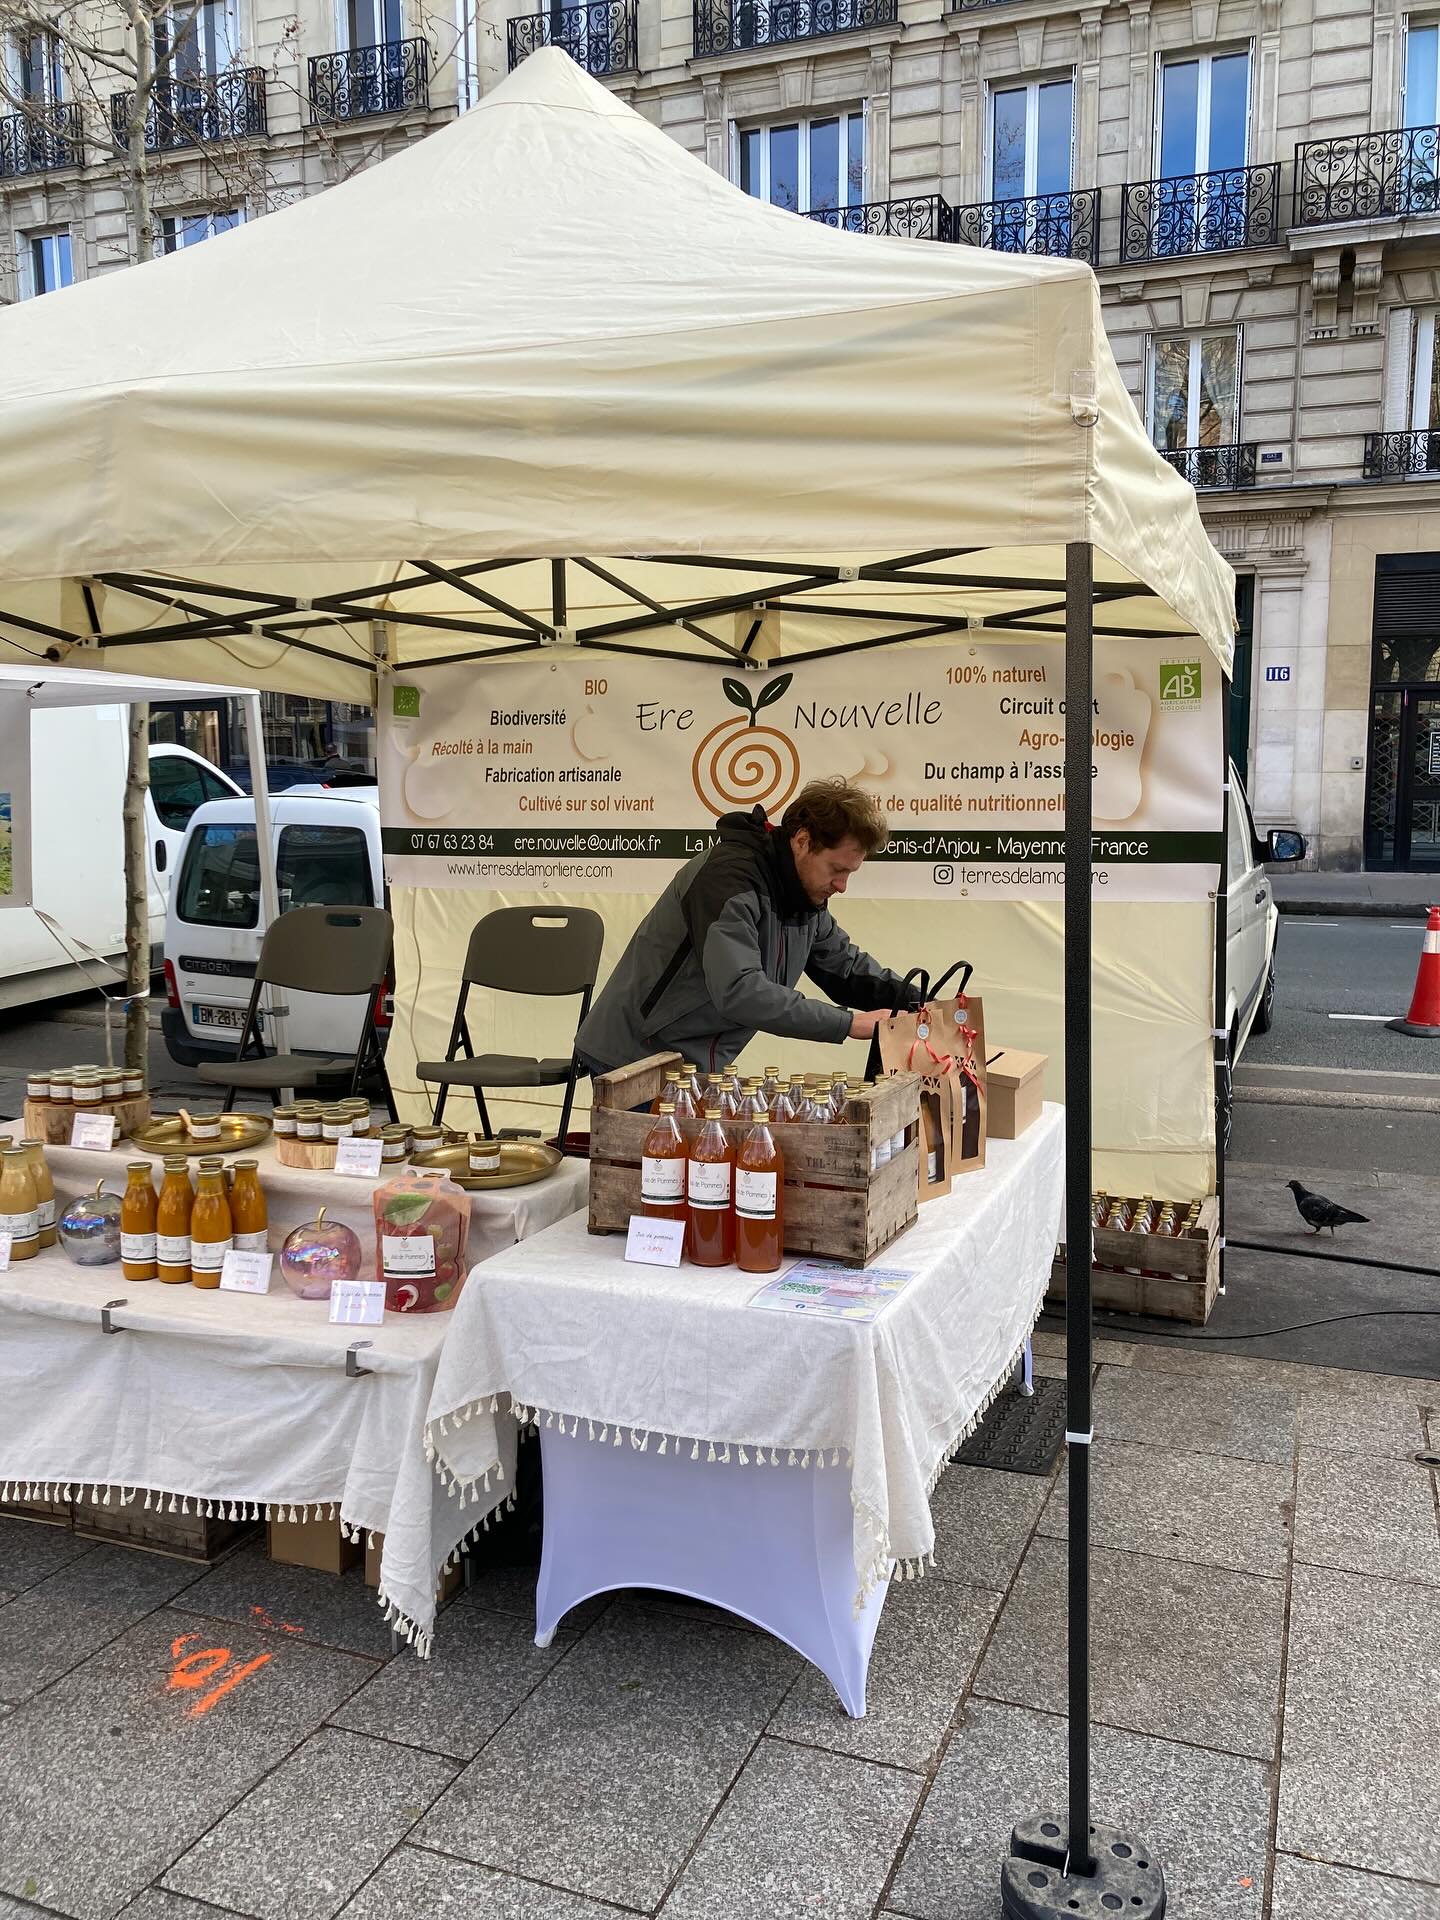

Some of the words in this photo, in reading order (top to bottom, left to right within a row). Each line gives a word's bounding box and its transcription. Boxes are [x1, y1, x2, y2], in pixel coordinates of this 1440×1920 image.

[946, 666, 987, 684] 100%
[992, 666, 1046, 683] naturel
[1268, 668, 1288, 680] 116
[585, 679, 608, 695] BIO
[1162, 675, 1196, 698] AB
[635, 702, 695, 731] Ere
[794, 692, 943, 729] Nouvelle
[1000, 697, 1054, 715] Circuit
[490, 709, 567, 726] Biodiversité
[432, 740, 473, 756] Récolté
[477, 740, 484, 754] à
[488, 739, 499, 754] la
[503, 740, 533, 754] main
[1019, 729, 1135, 751] Agro-logie
[485, 766, 555, 783] Fabrication
[558, 766, 622, 782] artisanale
[924, 762, 945, 779] Du
[951, 761, 1005, 783] champ
[1009, 761, 1017, 779] à
[519, 795, 562, 812] Cultivé
[566, 799, 587, 812] sur
[590, 796, 609, 811] sol
[614, 796, 655, 812] vivant
[886, 794, 905, 811] de
[910, 793, 962, 815] qualité
[411, 834, 424, 849] 07
[427, 834, 440, 849] 67
[443, 834, 458, 849] 63
[461, 834, 476, 849] 23
[478, 834, 494, 849] 84
[514, 834, 661, 852] ere.nouvelle@outlook.fr
[685, 835, 704, 852] La
[1091, 836, 1149, 855] France
[447, 860, 612, 878] www.terresdelamorliere.com
